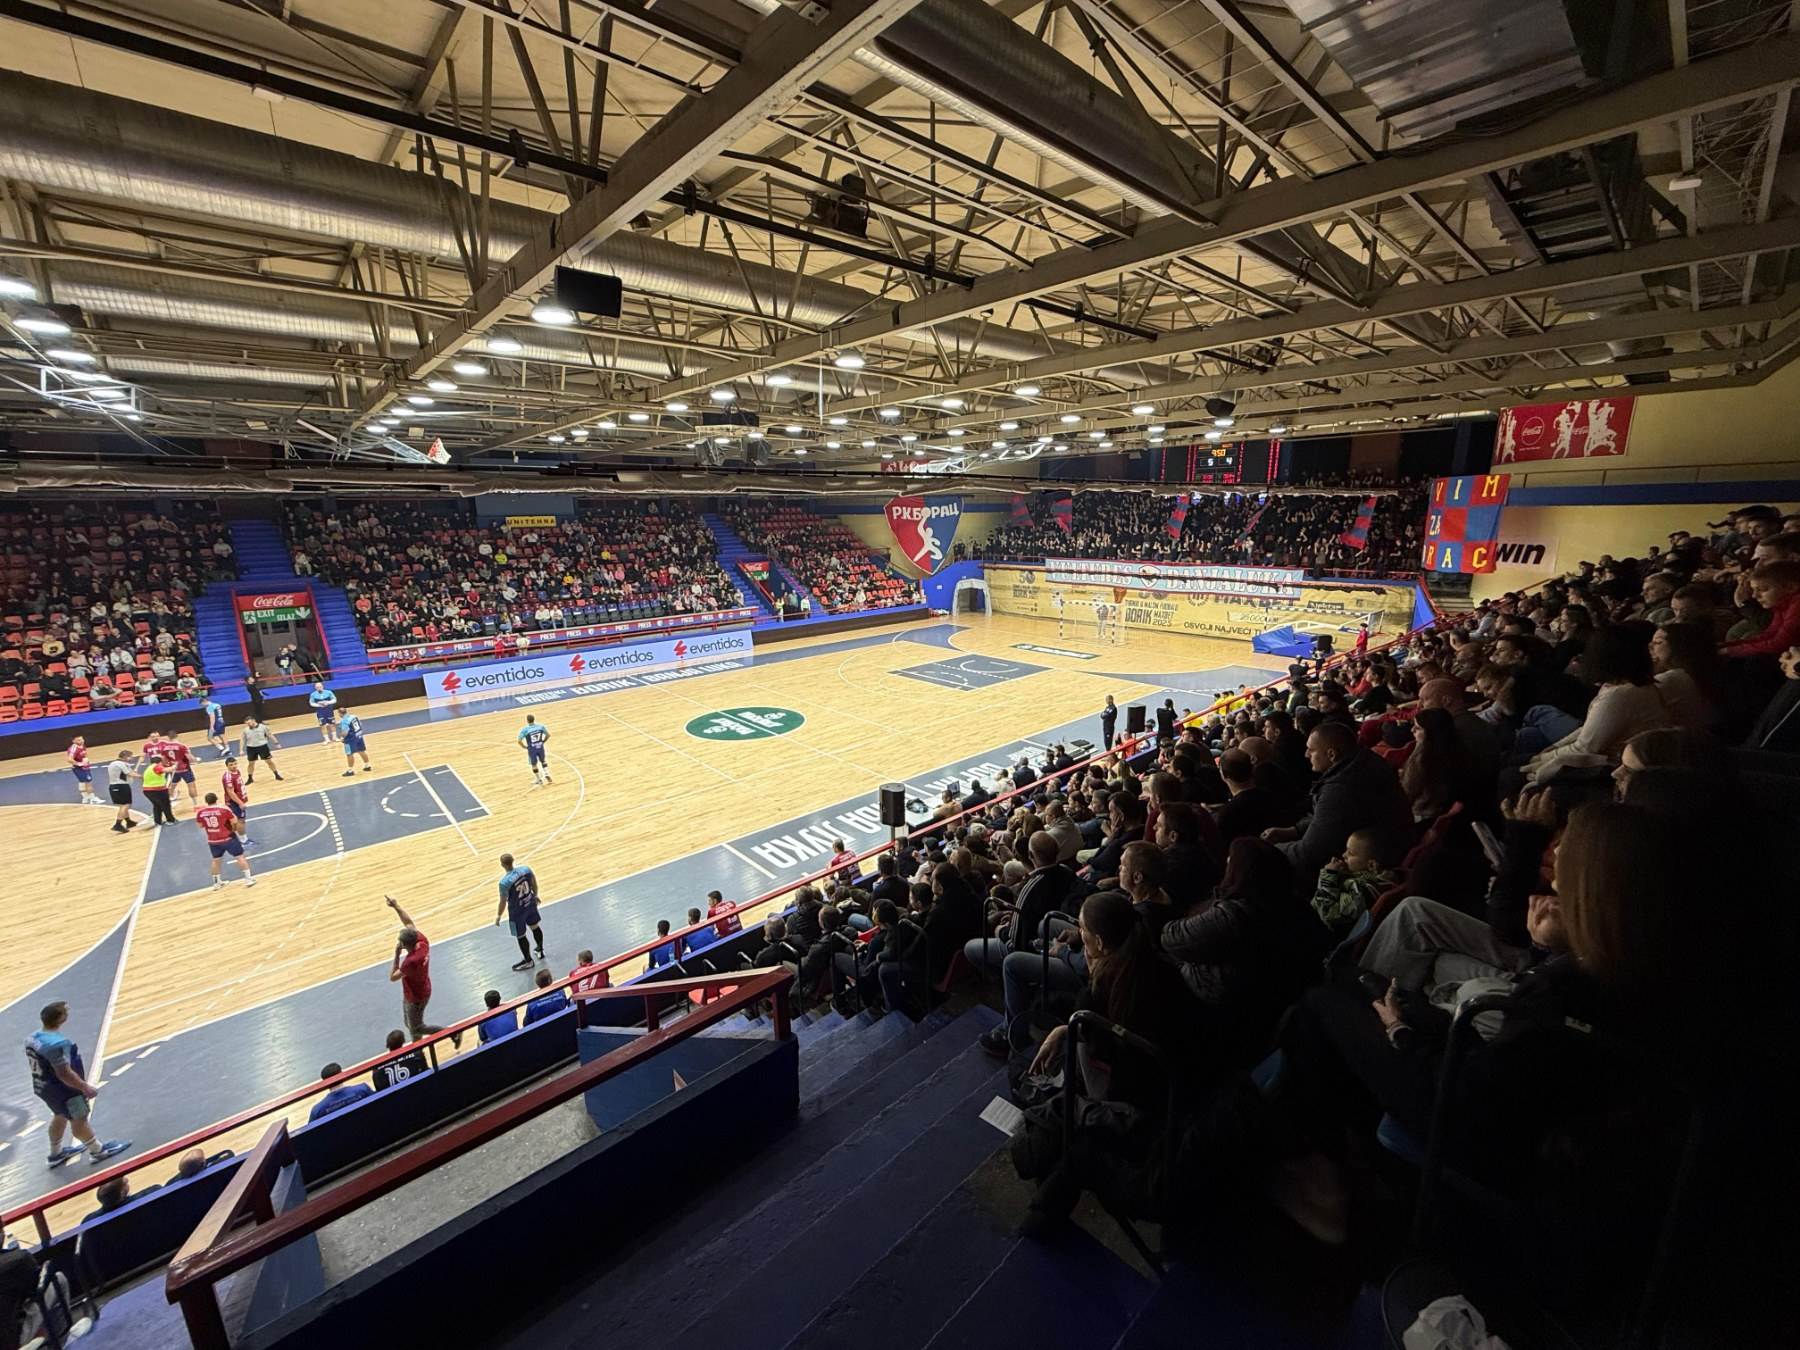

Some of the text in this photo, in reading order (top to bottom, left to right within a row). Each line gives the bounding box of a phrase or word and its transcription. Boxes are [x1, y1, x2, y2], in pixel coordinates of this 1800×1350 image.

[253, 594, 294, 608] Coca-Cola
[257, 609, 275, 618] EXIT
[701, 614, 714, 622] PRESS
[615, 624, 629, 632] PRESS
[638, 621, 652, 630] PRESS
[540, 632, 556, 641] PRESS
[566, 630, 582, 639] PRESS
[454, 641, 473, 651] PRESS
[689, 636, 744, 655] eventidos
[588, 648, 654, 670] eventidos
[465, 665, 545, 689] eventidos
[384, 1063, 411, 1086] 16
